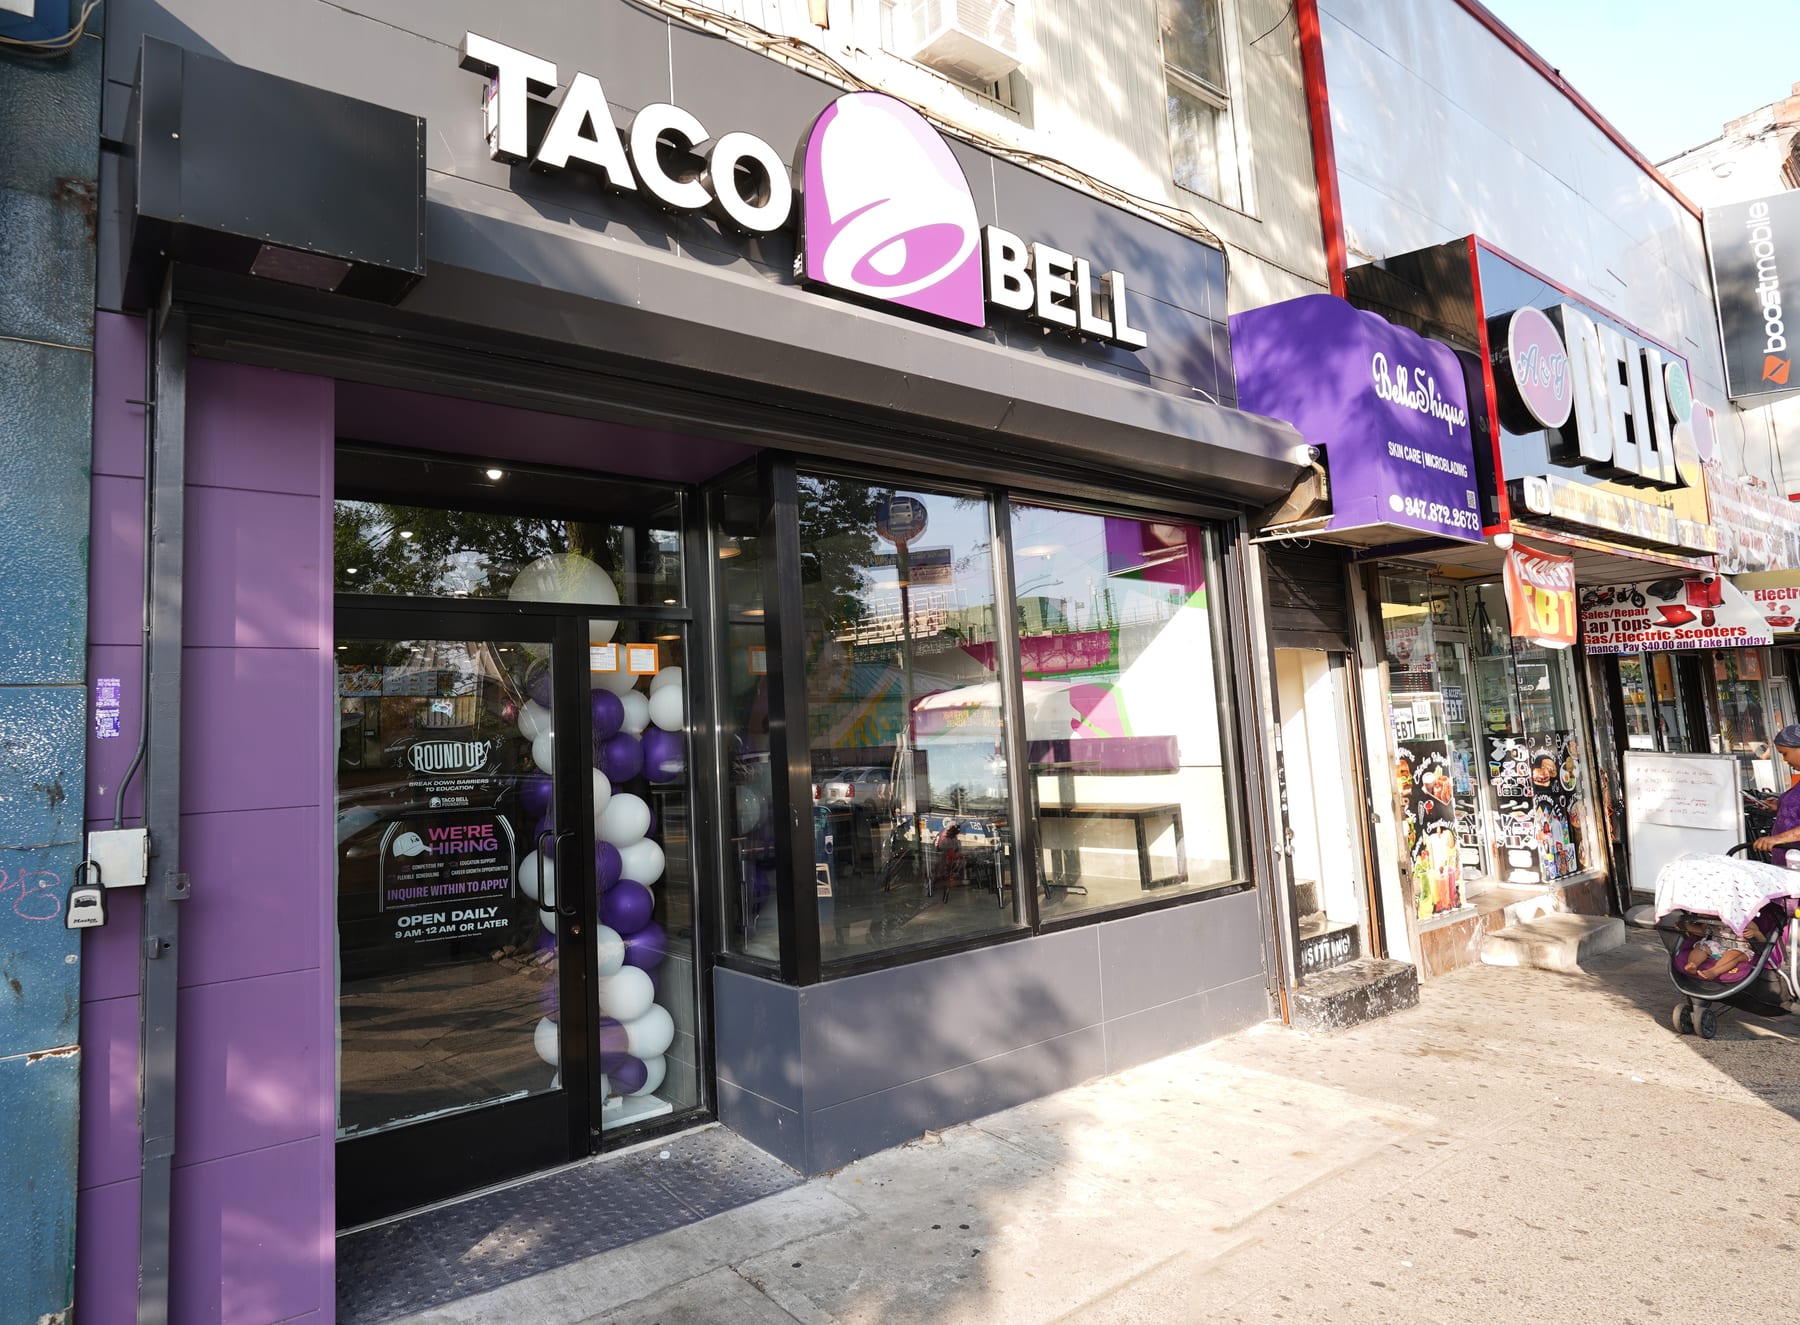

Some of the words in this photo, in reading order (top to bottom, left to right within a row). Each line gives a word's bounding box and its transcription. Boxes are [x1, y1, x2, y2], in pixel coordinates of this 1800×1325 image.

[461, 31, 792, 232] TACO
[985, 225, 1147, 351] BELL
[1562, 303, 1677, 486] DELI
[1388, 441, 1404, 457] SKIN
[1404, 446, 1422, 465] CARE
[1425, 453, 1468, 479] MICROBLADING
[1523, 585, 1574, 636] EBT
[1582, 608, 1650, 620] Sales/Repair
[1583, 621, 1609, 634] Lap
[1612, 618, 1652, 632] Tops
[1584, 630, 1671, 644] Gas/Electric
[1674, 626, 1747, 640] Scooters
[1623, 643, 1640, 652] Pay
[1641, 640, 1675, 651] $40.00
[1676, 640, 1696, 649] and
[1697, 639, 1722, 648] Take
[1724, 638, 1732, 647] it
[1445, 700, 1465, 721] EBT
[1395, 720, 1413, 740] EBT
[413, 743, 463, 771] ROUND
[465, 741, 485, 769] UP
[428, 824, 494, 840] WE'RE
[429, 838, 498, 856] HIRING
[387, 886, 429, 900] INQUIRE
[430, 882, 466, 896] WITHIN
[466, 880, 480, 892] TO
[481, 878, 509, 891] APPLY
[397, 912, 446, 928] OPEN
[451, 906, 499, 921] DAILY
[395, 931, 403, 939] 9
[438, 924, 456, 934] AM
[459, 923, 475, 932] OR
[477, 918, 509, 929] LATER
